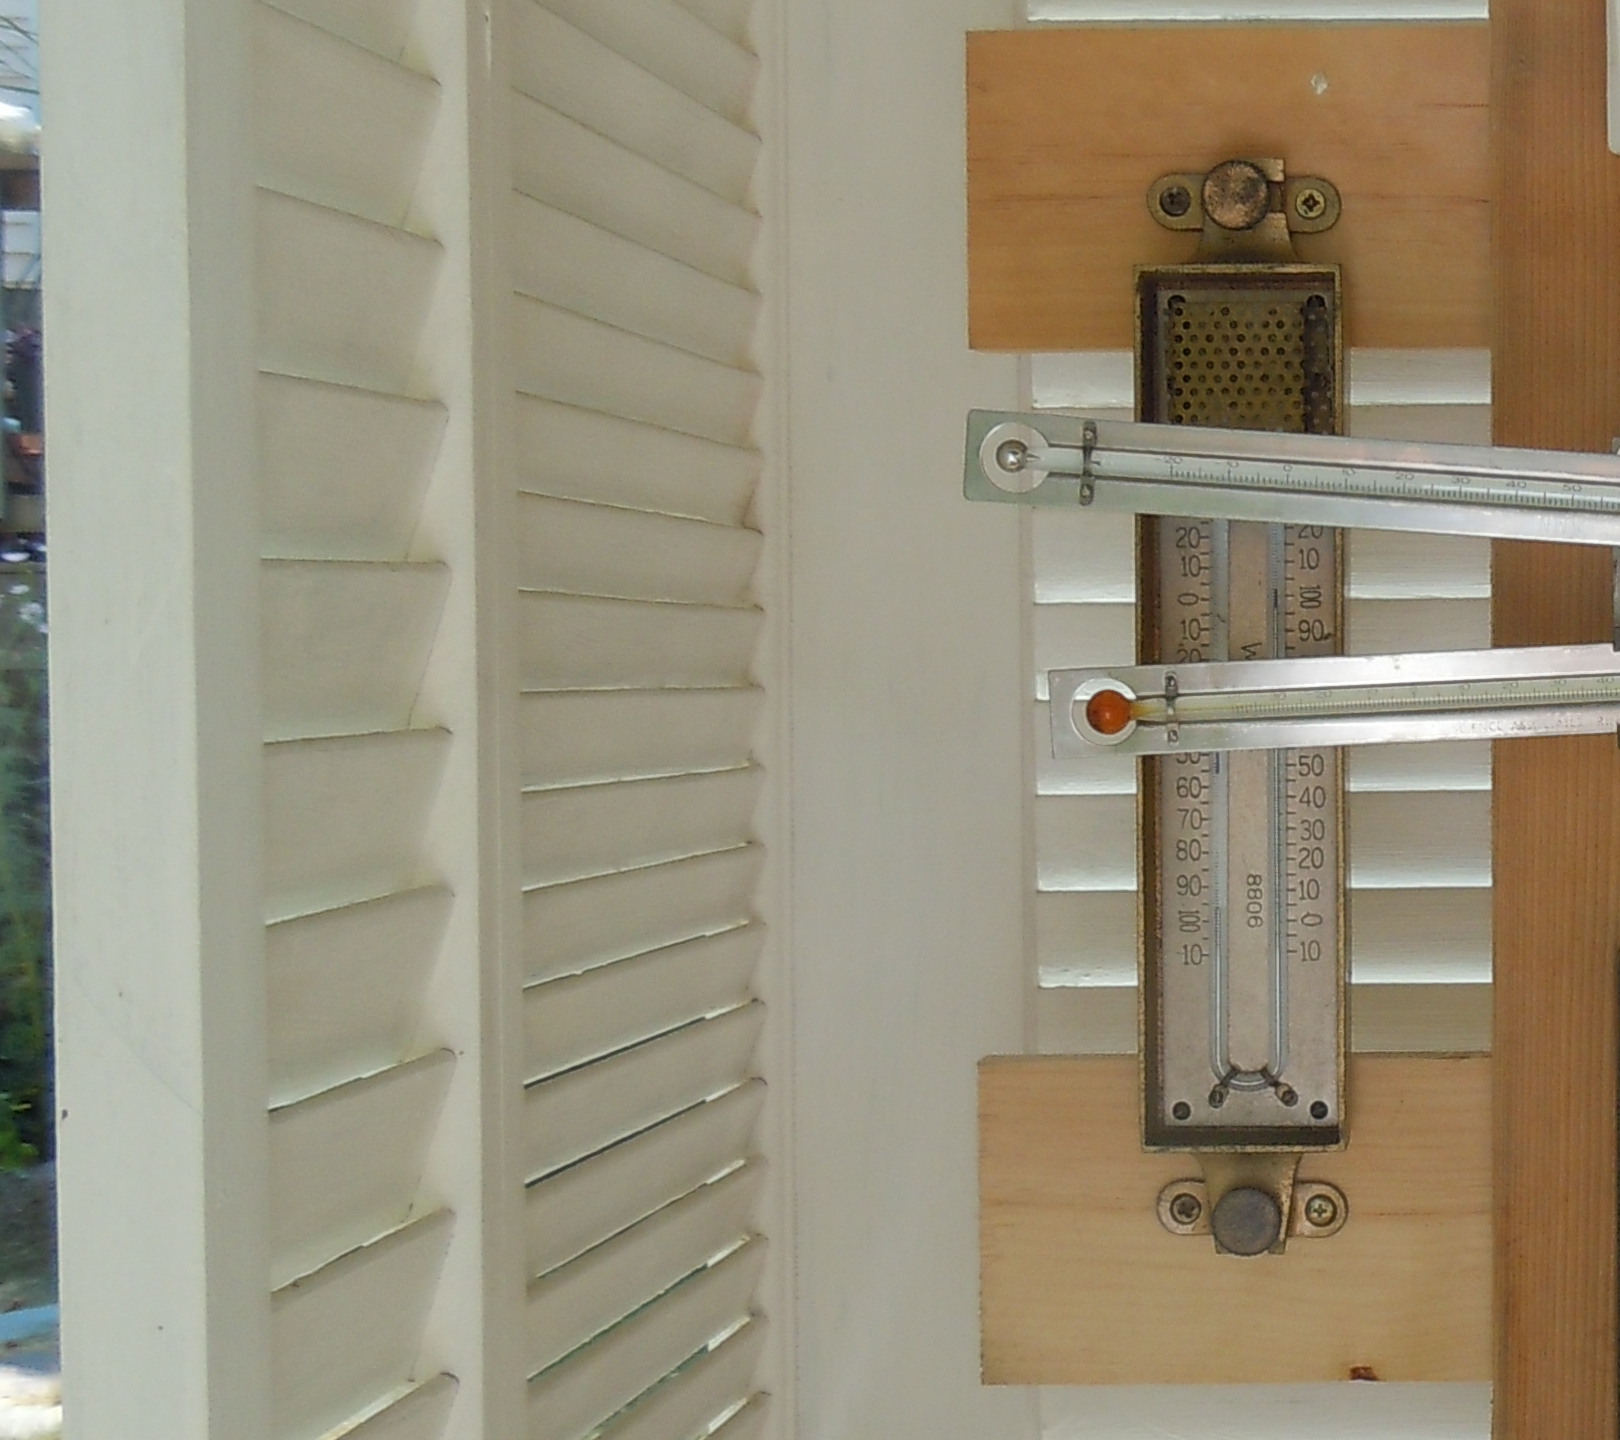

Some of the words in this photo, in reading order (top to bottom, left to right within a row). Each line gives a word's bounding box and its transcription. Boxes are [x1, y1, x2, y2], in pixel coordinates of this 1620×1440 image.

[1395, 471, 1415, 481] 20
[1452, 476, 1471, 485] 30
[1505, 480, 1527, 489] 40
[1562, 484, 1583, 492] 50
[1176, 527, 1200, 549] 20
[1180, 555, 1200, 577] 10
[1299, 548, 1320, 570] 10
[1178, 593, 1199, 606] 0
[1300, 585, 1321, 609] 100
[1180, 618, 1200, 641] 10
[1298, 620, 1324, 641] 90
[1299, 754, 1325, 777] 50
[1176, 776, 1201, 799] 60
[1300, 786, 1326, 808] 40
[1177, 808, 1202, 830] 70
[1301, 819, 1325, 841] 30
[1176, 839, 1201, 861] 80
[1299, 847, 1324, 869] 20
[1176, 874, 1201, 896] 90
[1300, 879, 1320, 900] 10
[1178, 910, 1200, 932] 100
[1301, 912, 1323, 927] 0
[1182, 944, 1202, 965] 10
[1301, 940, 1320, 961] 10
